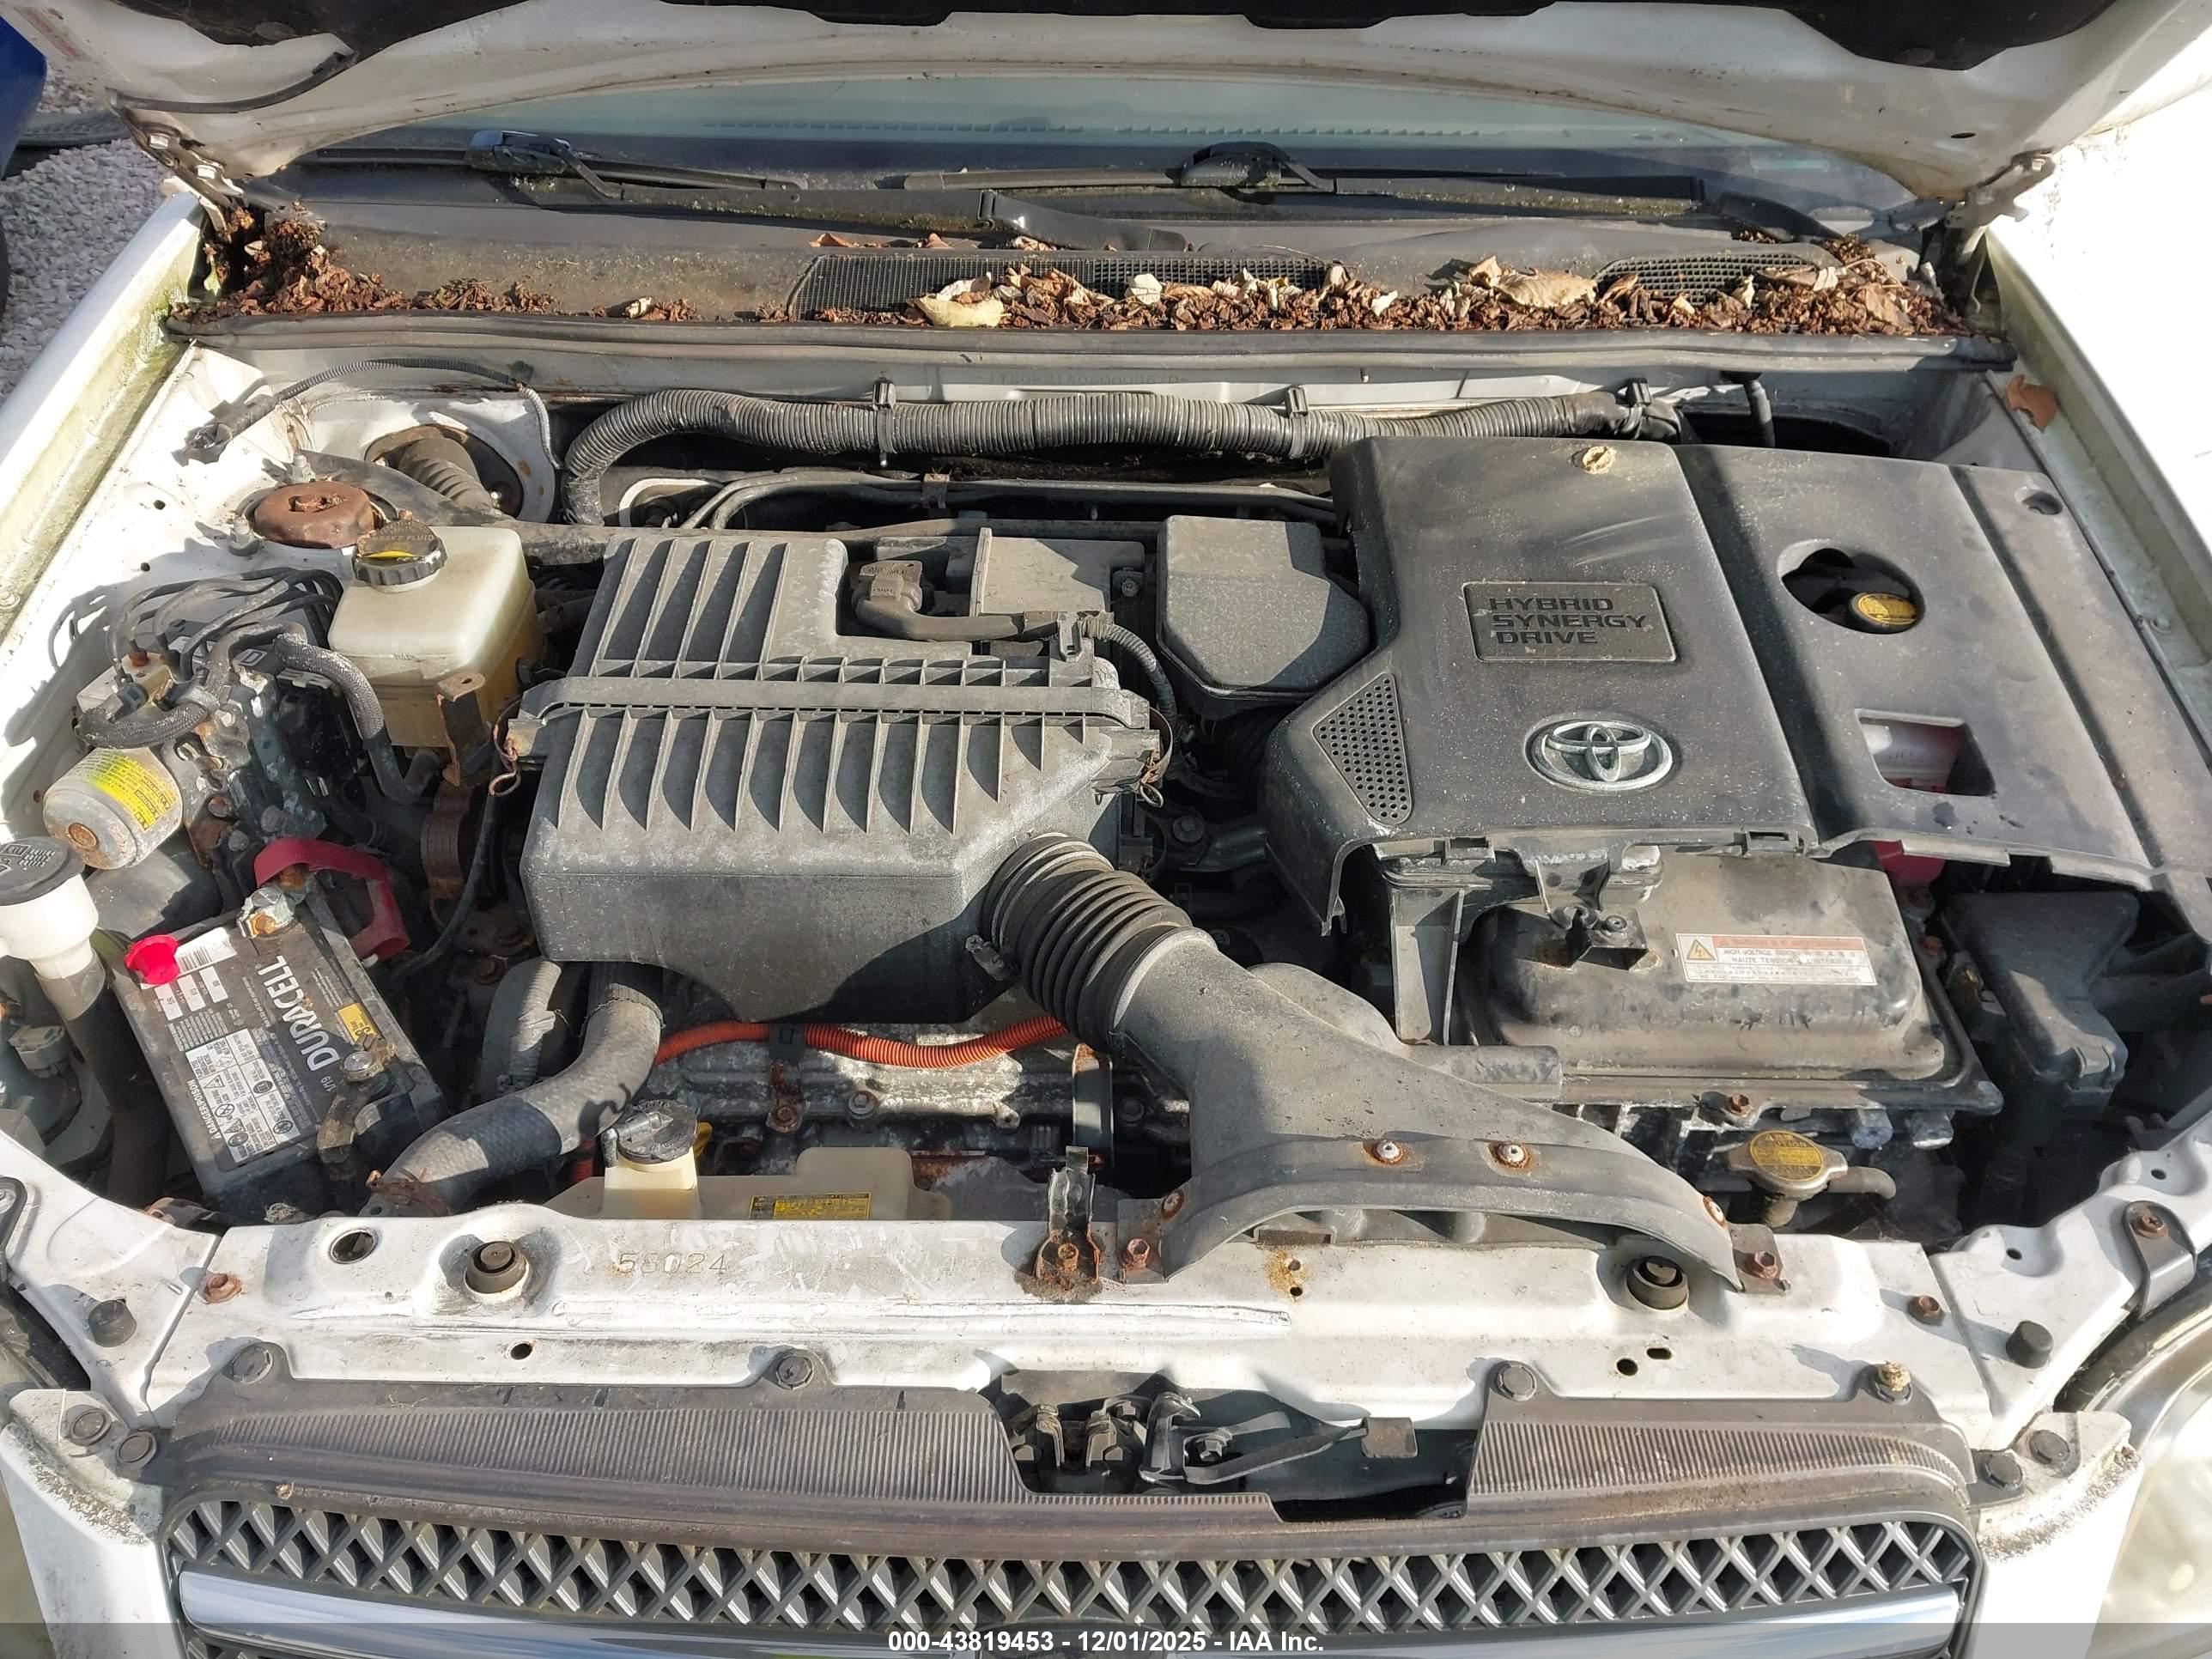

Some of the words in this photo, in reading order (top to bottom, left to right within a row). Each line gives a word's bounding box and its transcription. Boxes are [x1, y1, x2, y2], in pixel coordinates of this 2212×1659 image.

[1489, 597, 1613, 611] HYBRID
[1492, 614, 1647, 628] SYNERGY
[1495, 630, 1598, 644] DRIVE
[136, 790, 155, 812] CAUTION
[257, 955, 339, 1071] DURACELL
[319, 1075, 337, 1092] 1/19
